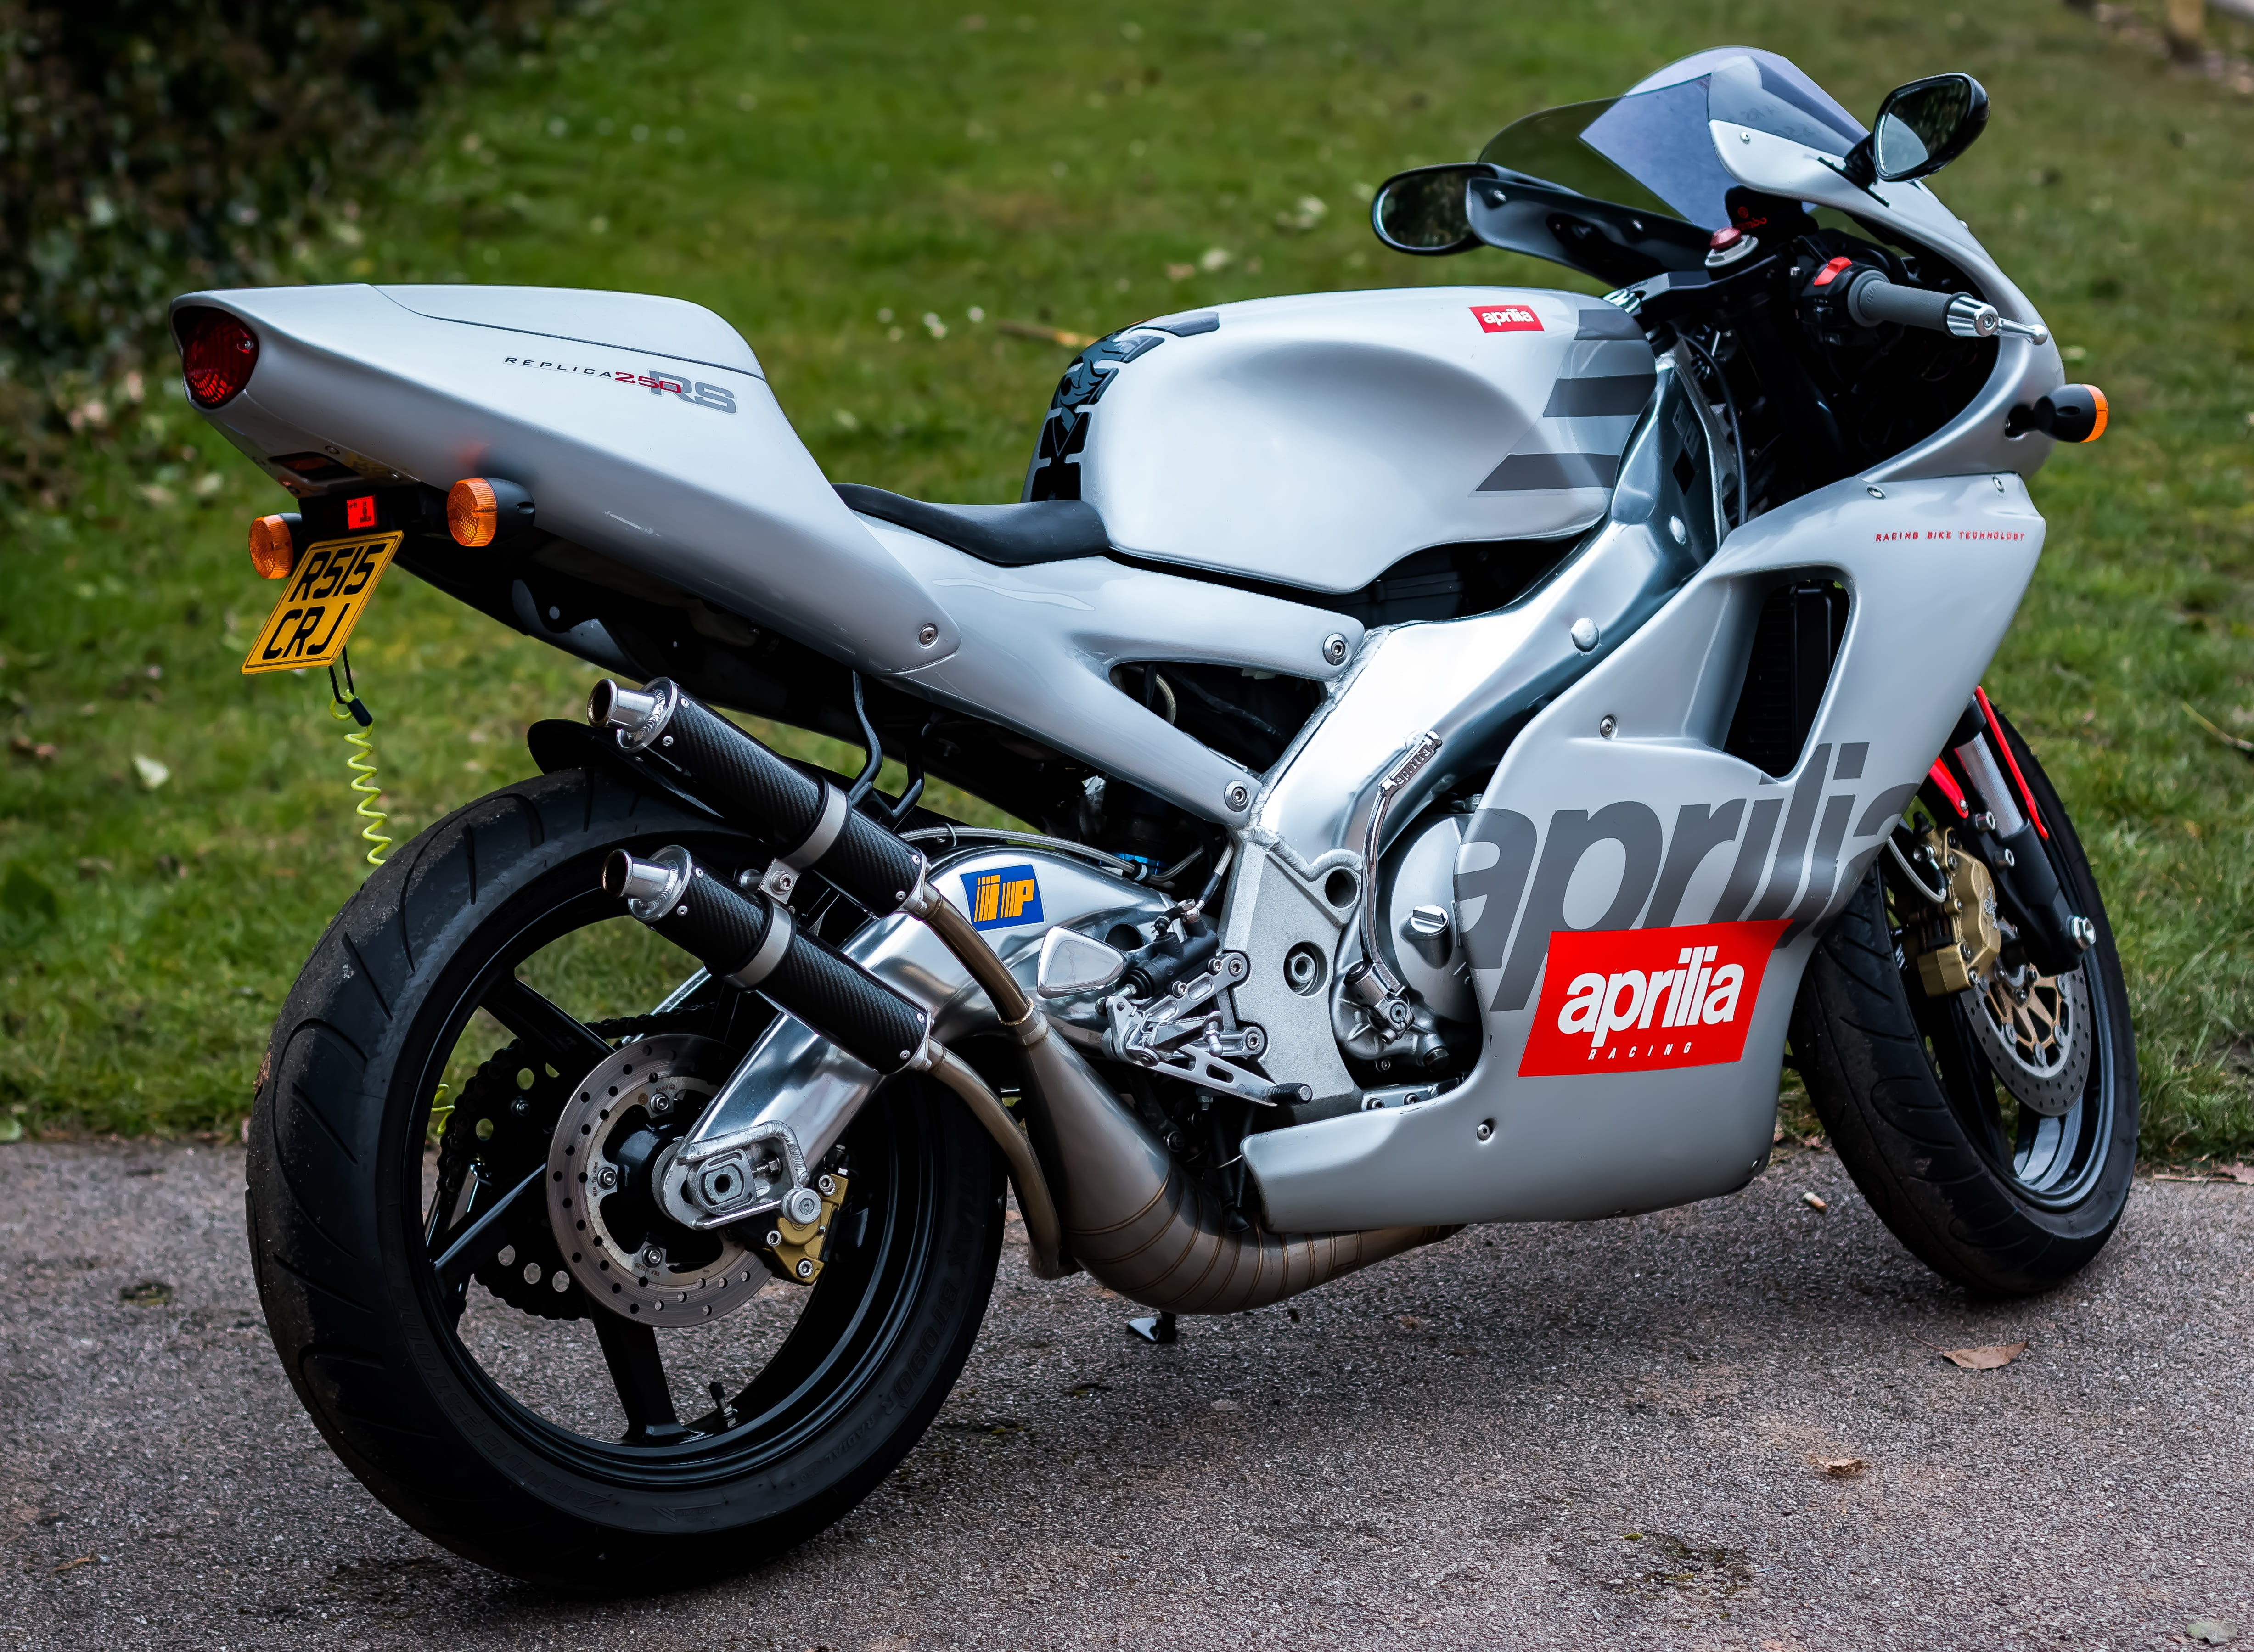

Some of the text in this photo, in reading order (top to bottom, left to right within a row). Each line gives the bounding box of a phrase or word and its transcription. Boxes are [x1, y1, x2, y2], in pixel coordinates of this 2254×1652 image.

[1482, 308, 1535, 326] aprilia
[505, 357, 737, 414] REPLICA 250 RS
[1876, 531, 2025, 542] RACING BIKE TECHNOLOGY
[288, 542, 388, 603] R515
[262, 603, 351, 660] CRJ
[1396, 748, 1431, 785] aprilia
[1557, 945, 1745, 1048] aprilia
[1587, 1042, 1692, 1060] RACING
